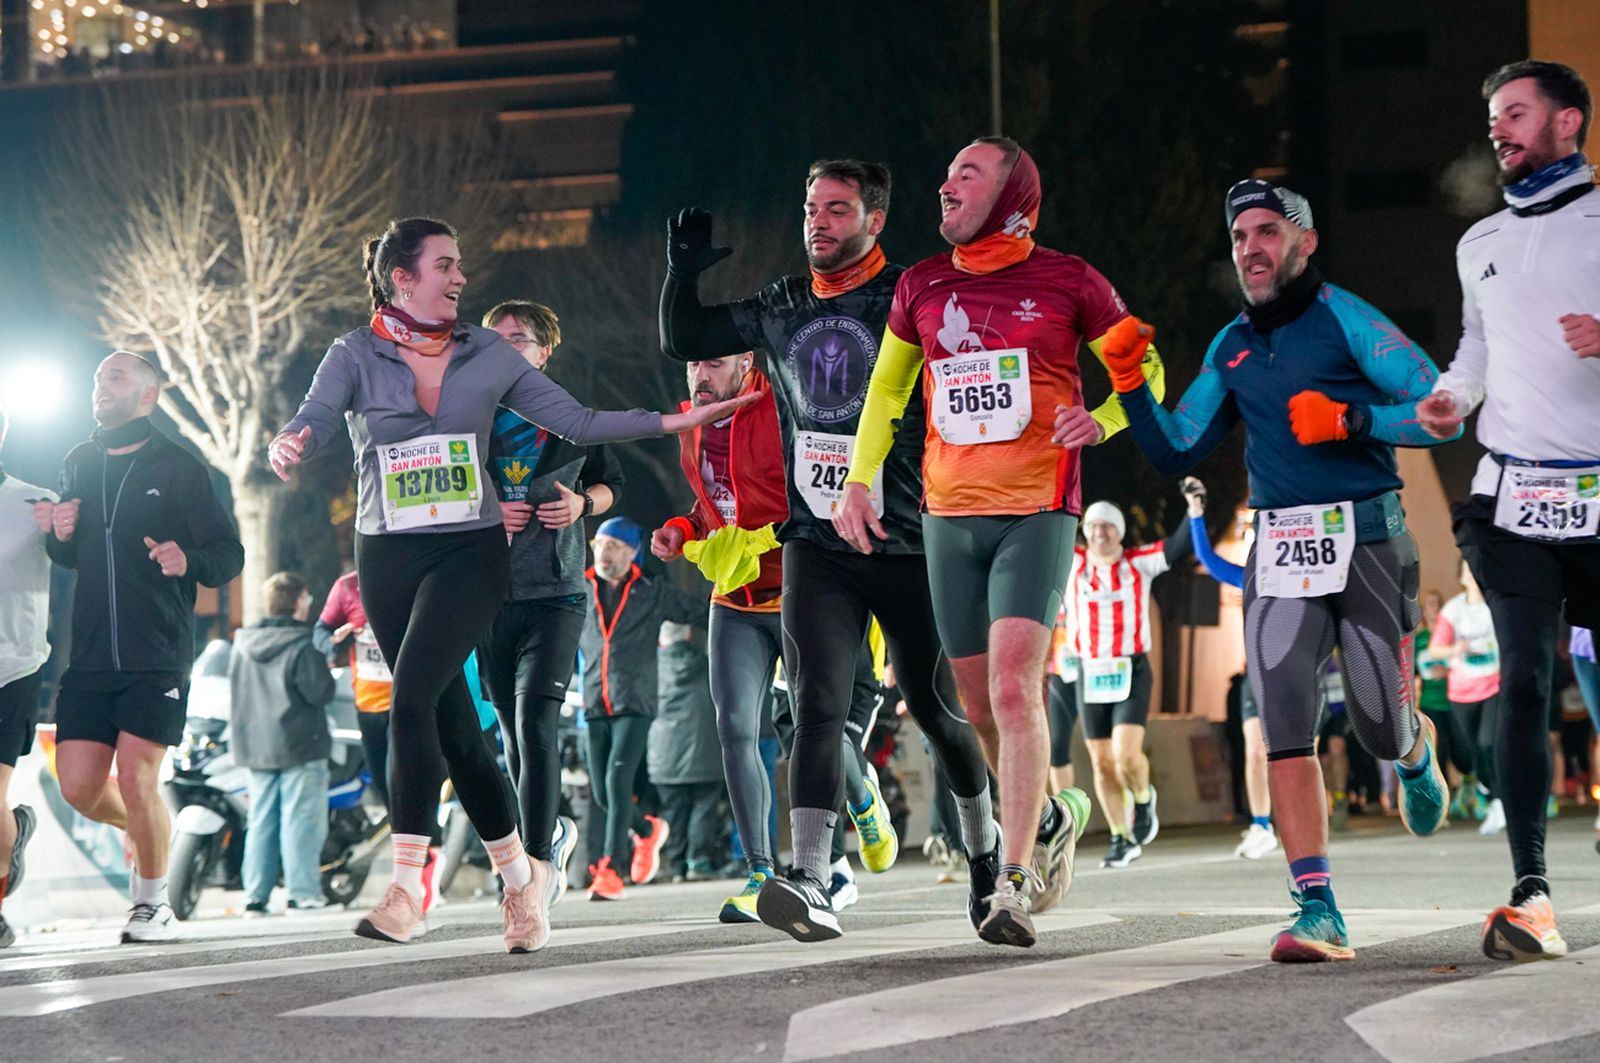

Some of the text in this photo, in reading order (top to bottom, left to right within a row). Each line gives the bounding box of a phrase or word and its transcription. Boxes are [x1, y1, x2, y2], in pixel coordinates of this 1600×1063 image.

[797, 321, 823, 342] CENTRO
[952, 364, 977, 374] NOCHE
[978, 362, 990, 371] DE
[944, 375, 960, 388] SAN
[949, 382, 1013, 414] 5653
[817, 411, 835, 419] SAN
[401, 446, 427, 459] NOCHE
[429, 445, 441, 454] DE
[813, 442, 848, 453] NOCHE DE
[804, 451, 818, 460] SAN
[391, 461, 409, 473] SAN
[395, 465, 468, 498] 13789
[1275, 537, 1337, 567] 2458
